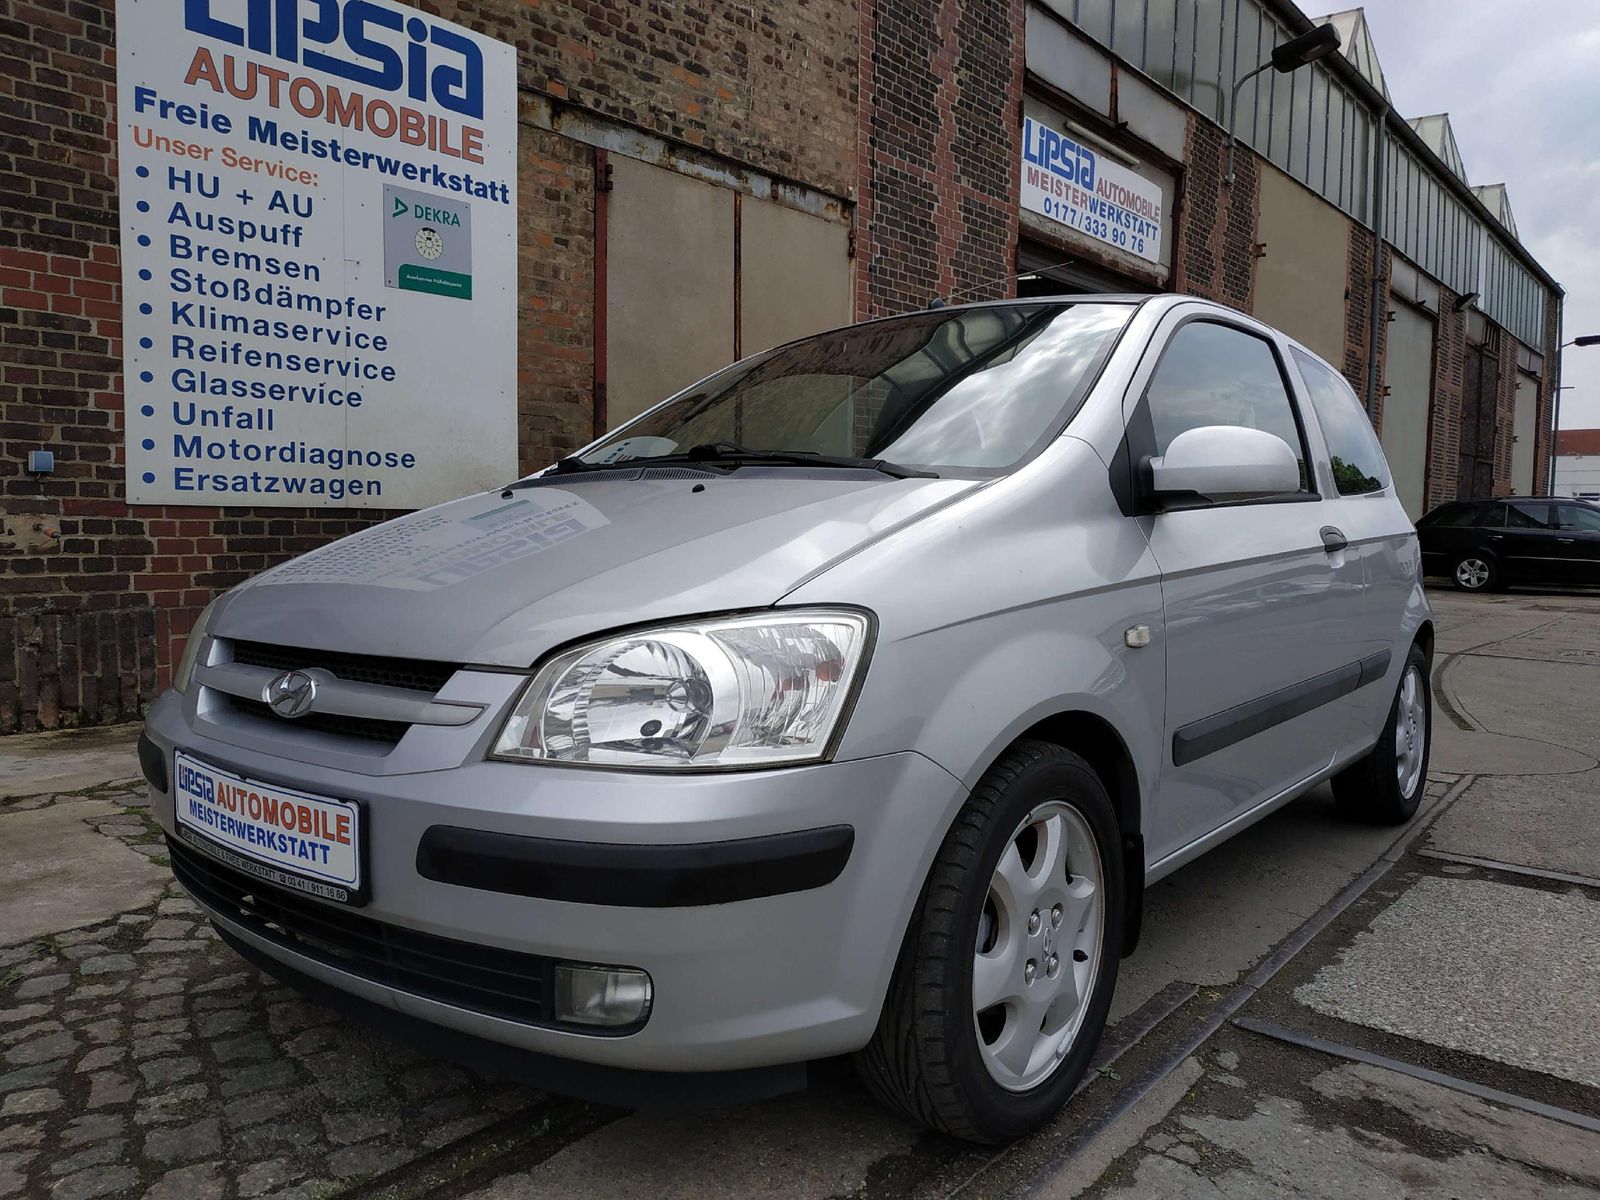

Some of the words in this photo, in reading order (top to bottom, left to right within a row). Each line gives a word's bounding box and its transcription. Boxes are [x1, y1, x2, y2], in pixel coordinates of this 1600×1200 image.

[184, 47, 484, 165] AUTOMOBILE
[133, 125, 213, 162] Unser
[221, 147, 319, 187] Service:
[134, 86, 232, 134] Freie
[248, 116, 510, 204] Meisterwerkstatt
[168, 166, 220, 199] HU
[236, 189, 254, 206] +
[268, 190, 313, 218] AU
[414, 204, 461, 227] DEKRA
[1027, 165, 1158, 241] MEISTERWERKSTATT
[1096, 177, 1160, 224] AUTOMOBILE
[168, 201, 303, 247] Auspuff
[1112, 228, 1126, 247] 90
[1131, 235, 1144, 253] 76
[170, 234, 320, 282] Bremsen
[170, 268, 386, 322] Stoßdämpfer
[171, 301, 388, 352] Klimaservice
[172, 334, 396, 382] Reifenservice
[171, 368, 363, 408] Glasservice
[173, 401, 274, 431] Unfall
[173, 435, 416, 470] Motordiagnose
[174, 467, 382, 499] Ersatzwagen
[189, 798, 330, 864] MEISTERWERKSTATT
[216, 782, 350, 845] AUTOMOBILE
[241, 858, 276, 880] WERKSTATT
[311, 883, 323, 896] 911
